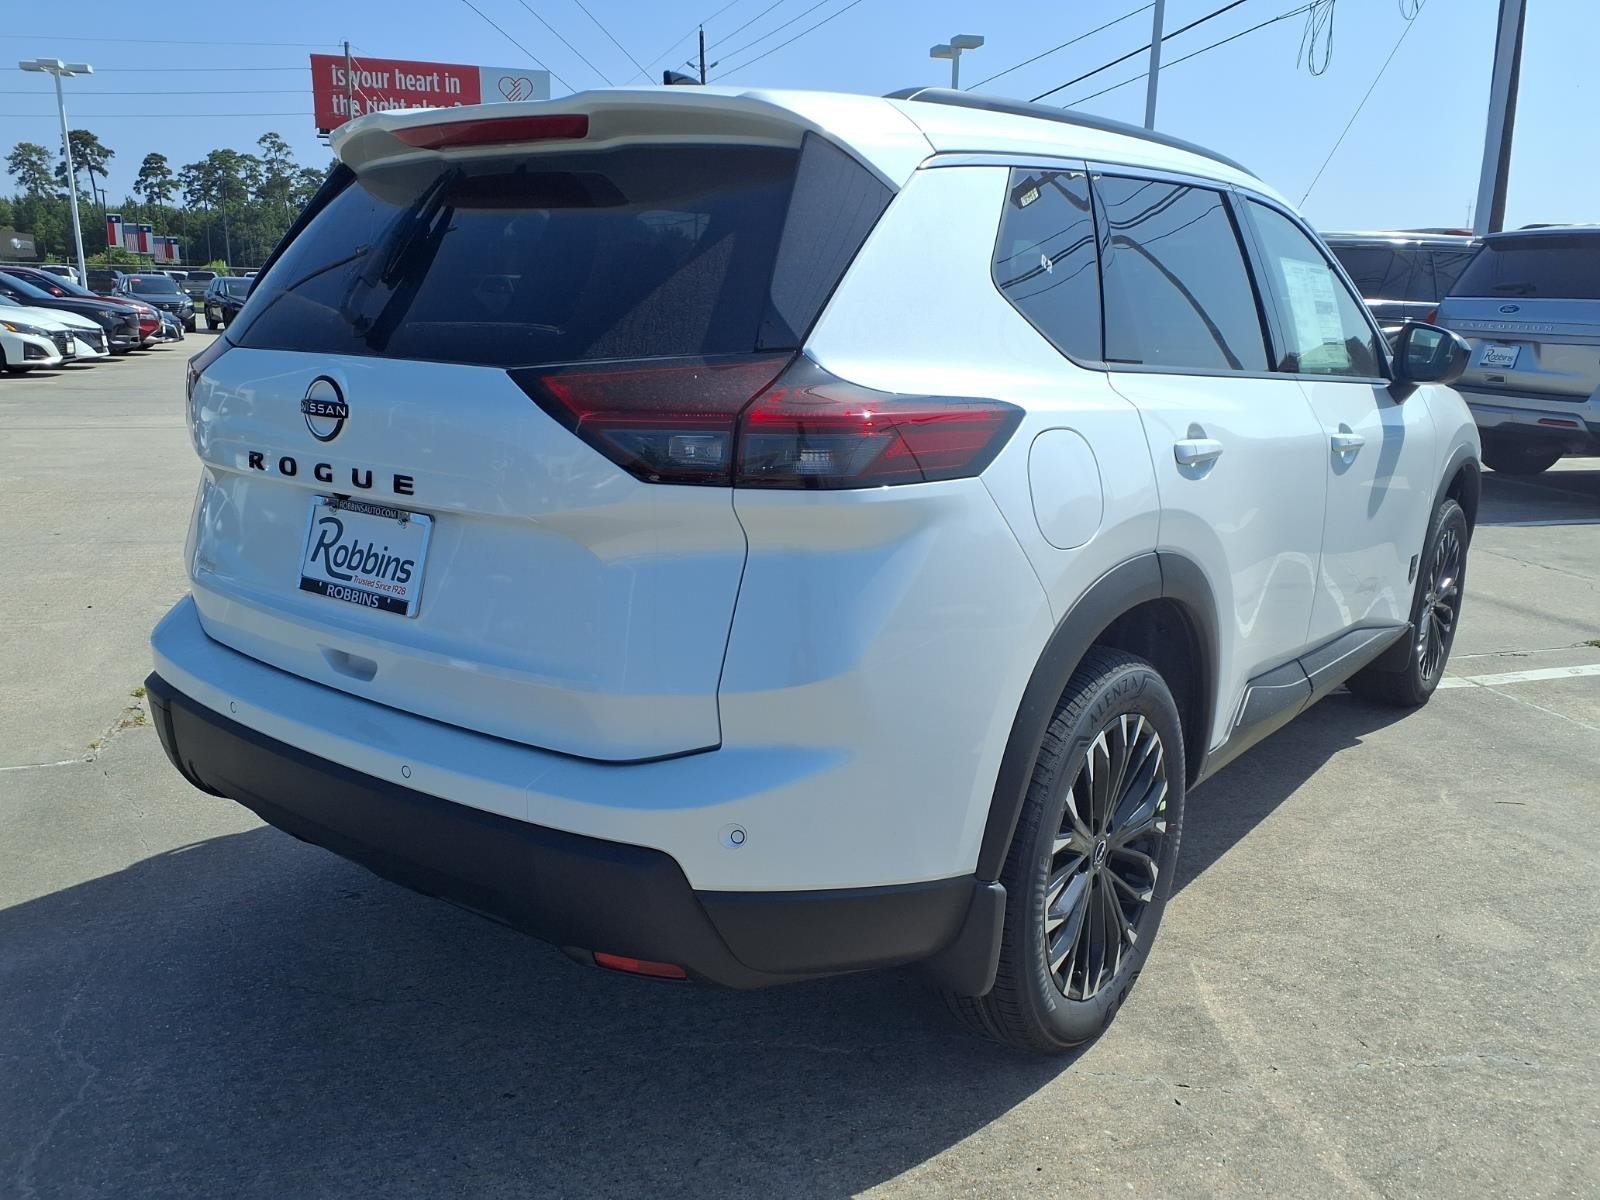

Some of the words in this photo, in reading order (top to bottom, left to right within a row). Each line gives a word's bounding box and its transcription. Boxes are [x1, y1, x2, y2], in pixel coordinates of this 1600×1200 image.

[331, 65, 346, 86] is
[350, 70, 390, 90] your
[395, 68, 440, 93] heart
[445, 72, 461, 94] in
[332, 94, 361, 116] the
[301, 401, 346, 417] NISSAN
[249, 451, 415, 496] ROGUE
[310, 516, 415, 584] Robbins
[353, 575, 375, 588] Trusted
[375, 580, 391, 592] Since
[326, 585, 380, 608] ROBBINS
